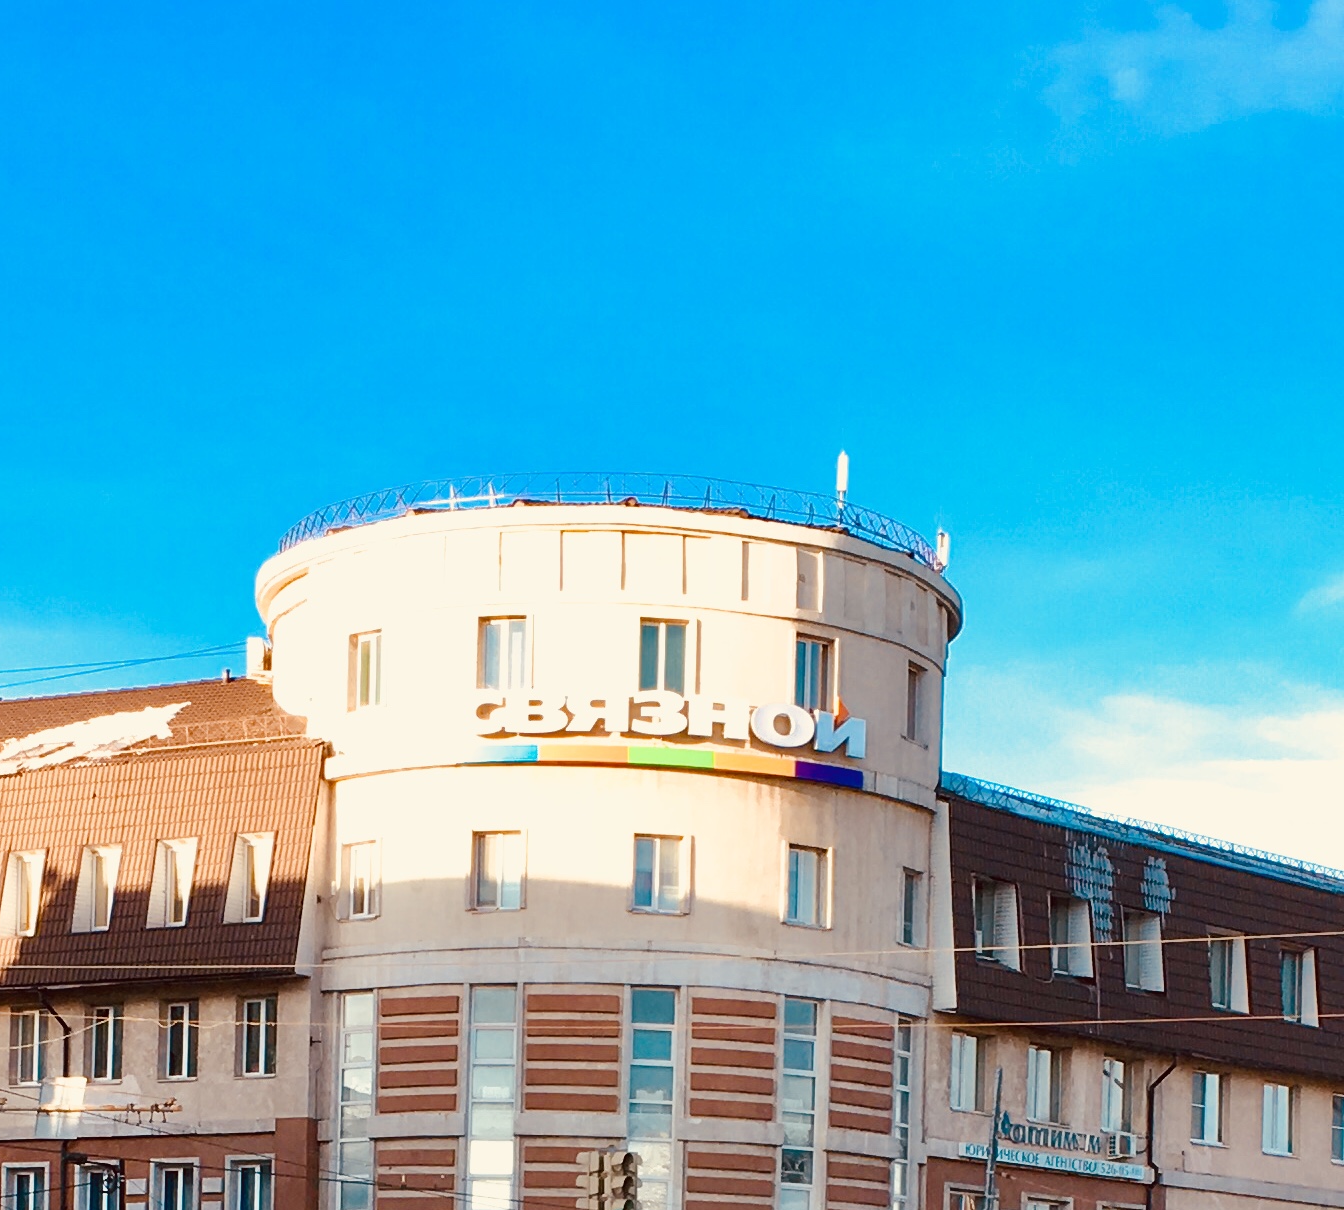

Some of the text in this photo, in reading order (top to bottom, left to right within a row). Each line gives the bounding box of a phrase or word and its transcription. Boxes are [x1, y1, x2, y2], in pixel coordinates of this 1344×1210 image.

[475, 689, 866, 759] СВЯЗНОЙ
[965, 1143, 1039, 1165] ЮРИИЧЕСКОЕ
[1044, 1154, 1097, 1174] АГЕНТСТВО
